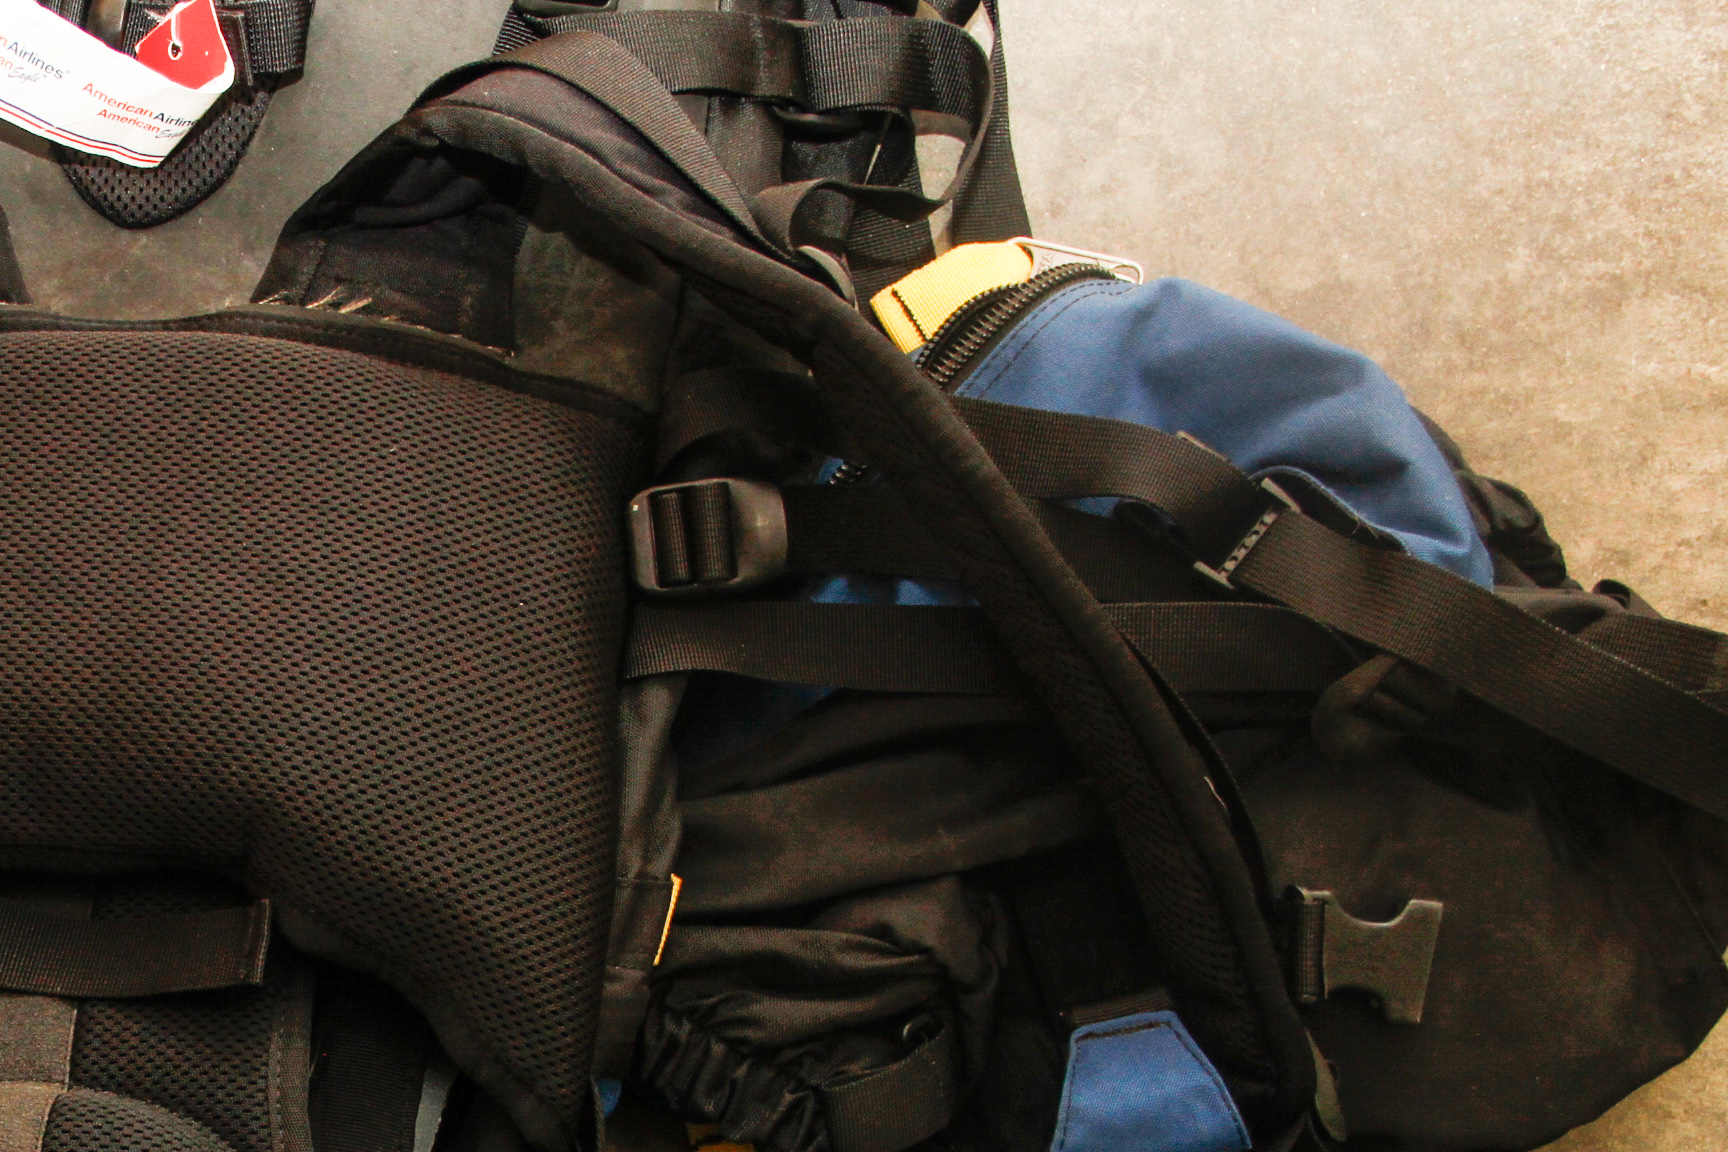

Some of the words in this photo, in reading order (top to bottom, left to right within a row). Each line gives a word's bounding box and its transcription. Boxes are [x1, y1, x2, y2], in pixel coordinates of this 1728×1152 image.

[7, 42, 64, 79] Airlines
[81, 83, 153, 117] American
[97, 109, 160, 133] American
